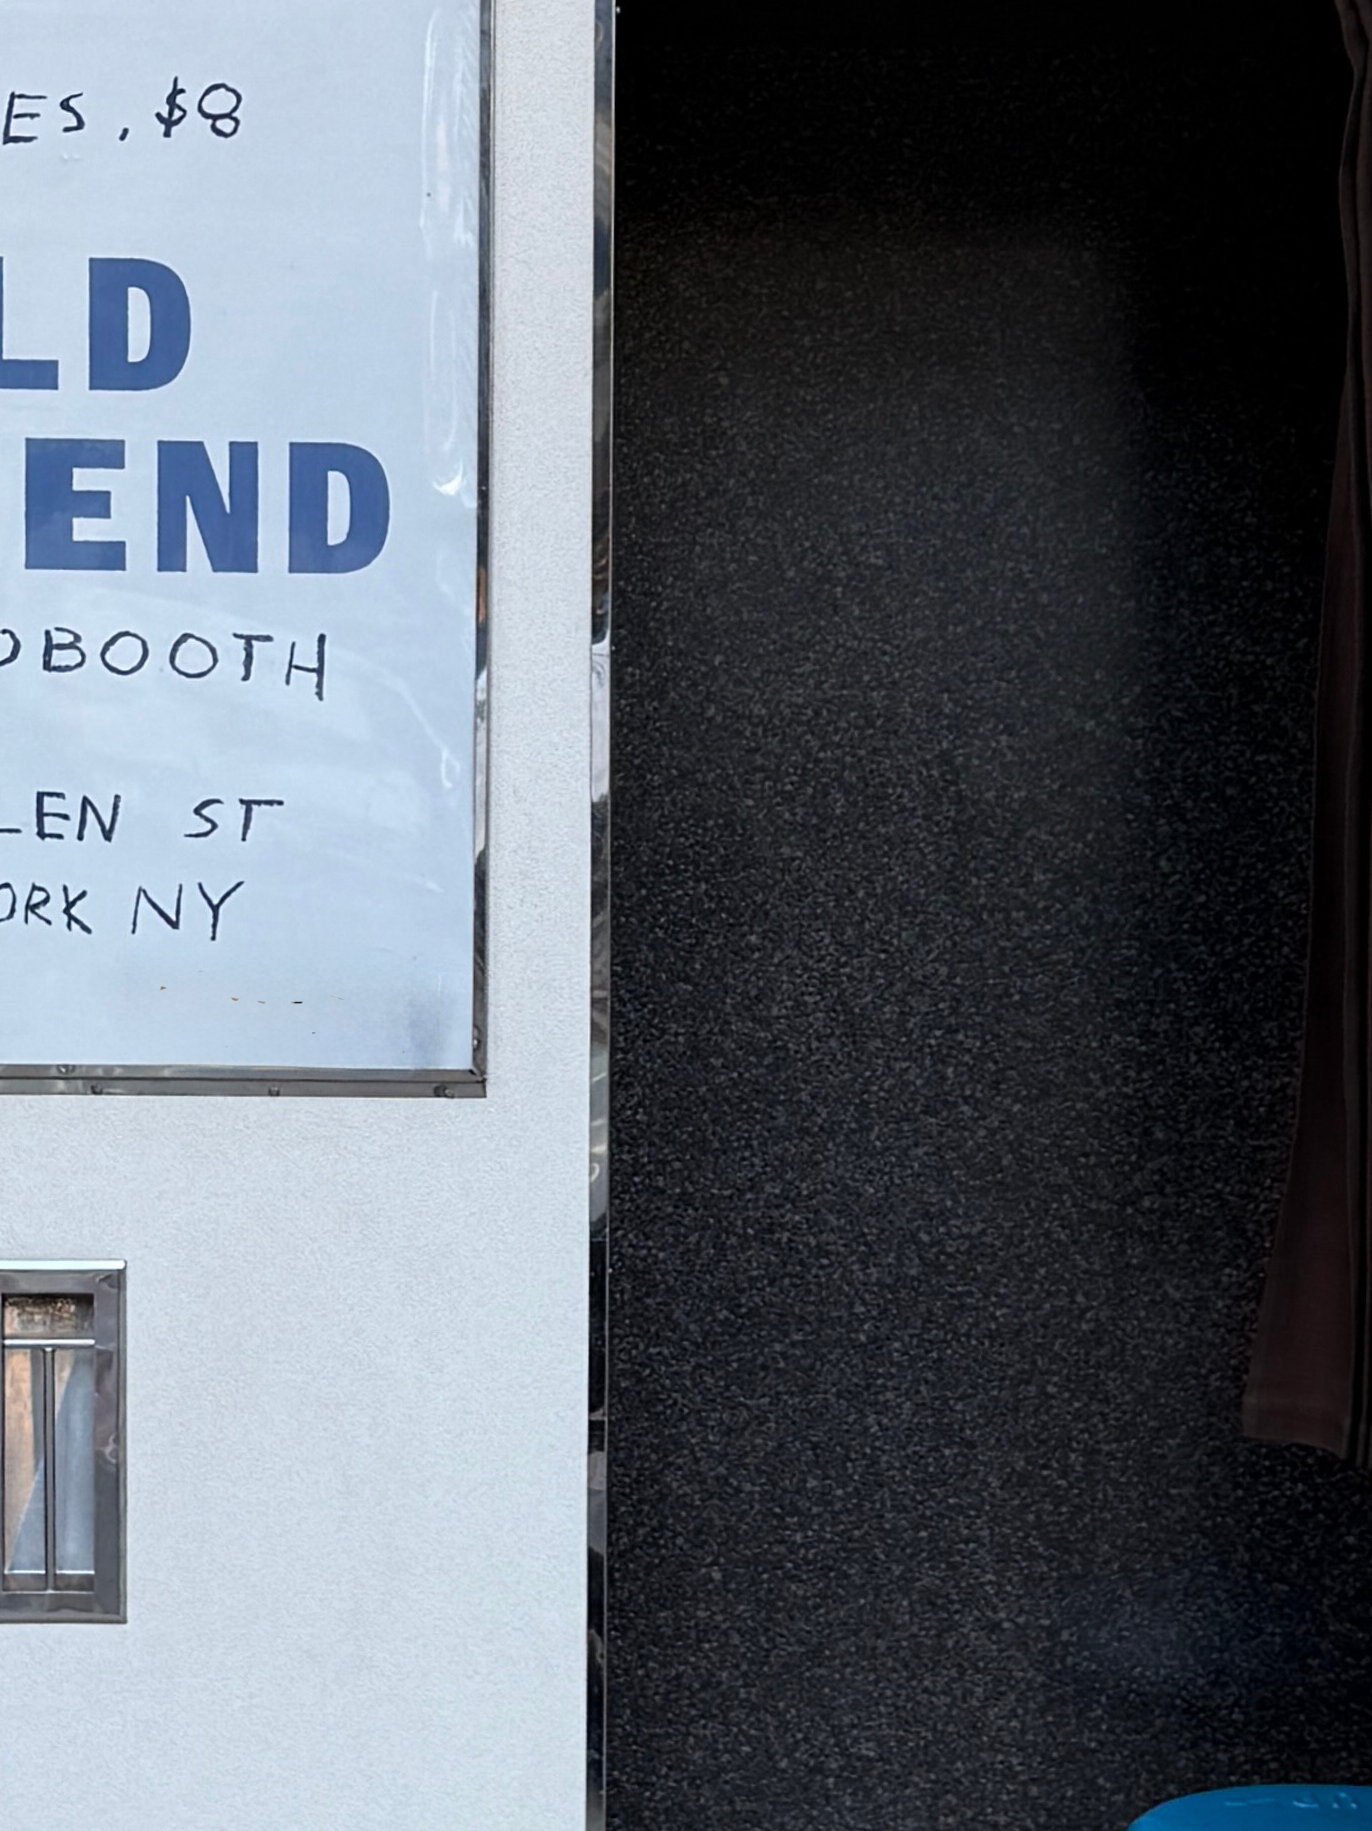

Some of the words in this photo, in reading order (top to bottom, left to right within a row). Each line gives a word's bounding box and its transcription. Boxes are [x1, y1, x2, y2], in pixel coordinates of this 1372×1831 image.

[153, 74, 244, 140] $8
[182, 795, 286, 844] ST
[129, 879, 246, 943] NY
